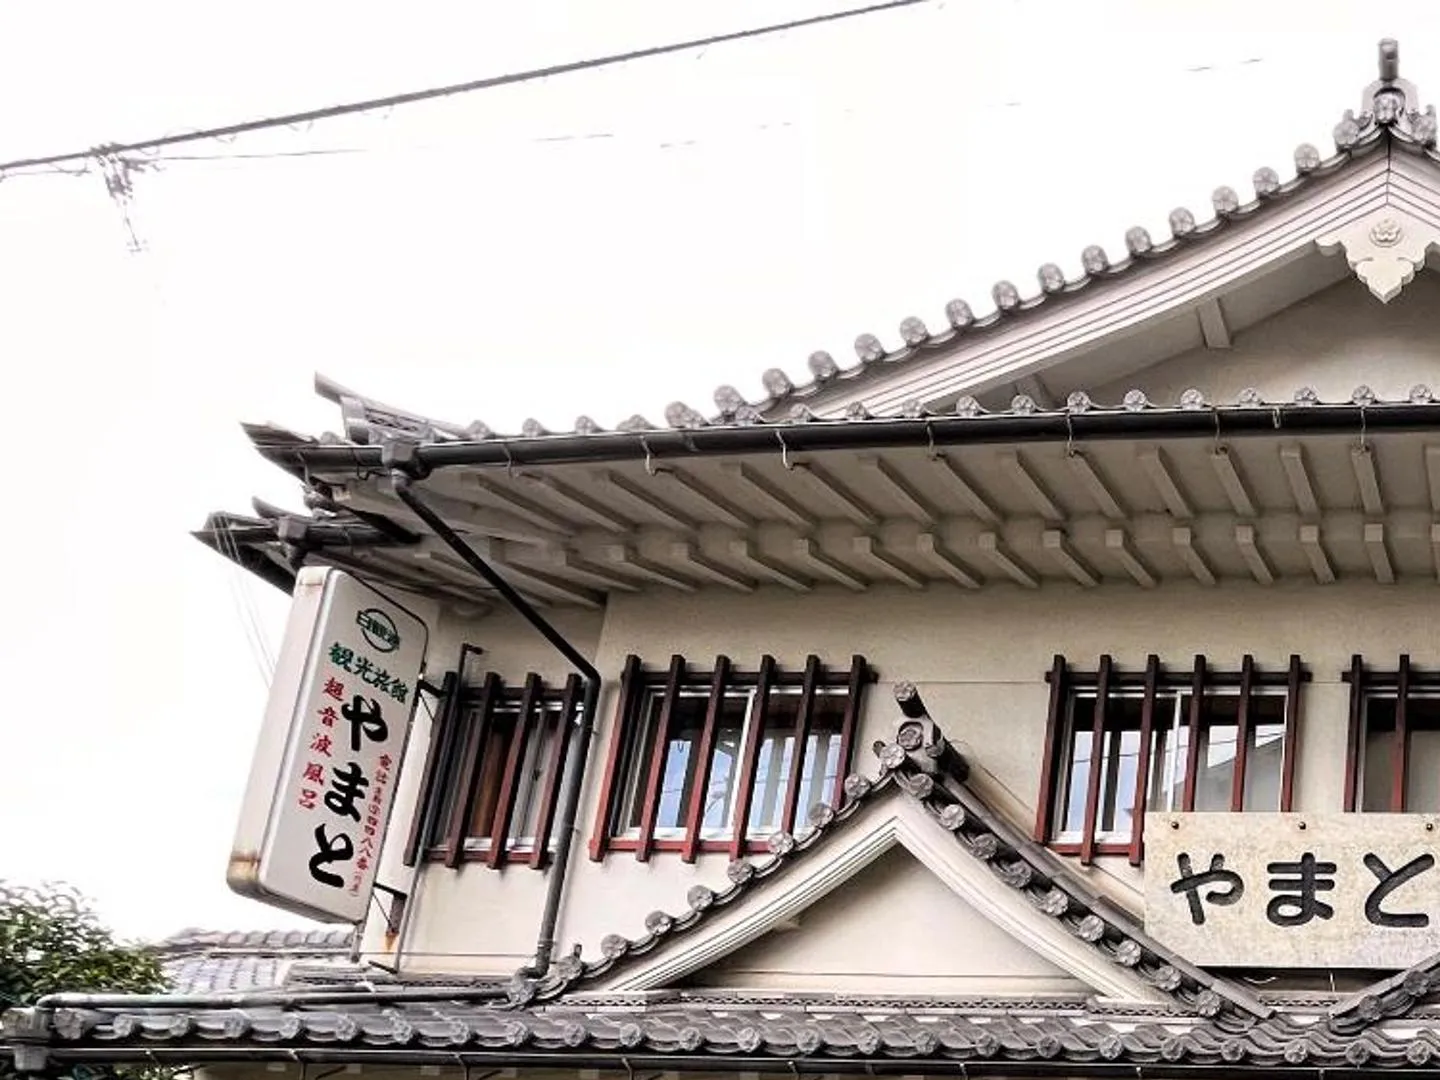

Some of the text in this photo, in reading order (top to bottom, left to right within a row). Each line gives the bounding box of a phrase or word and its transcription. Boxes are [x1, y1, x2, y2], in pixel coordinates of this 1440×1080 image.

[328, 641, 409, 704] 観光旅館
[299, 676, 345, 811] 超音波風呂
[309, 694, 389, 888] やまと
[1170, 852, 1436, 928] やまと
